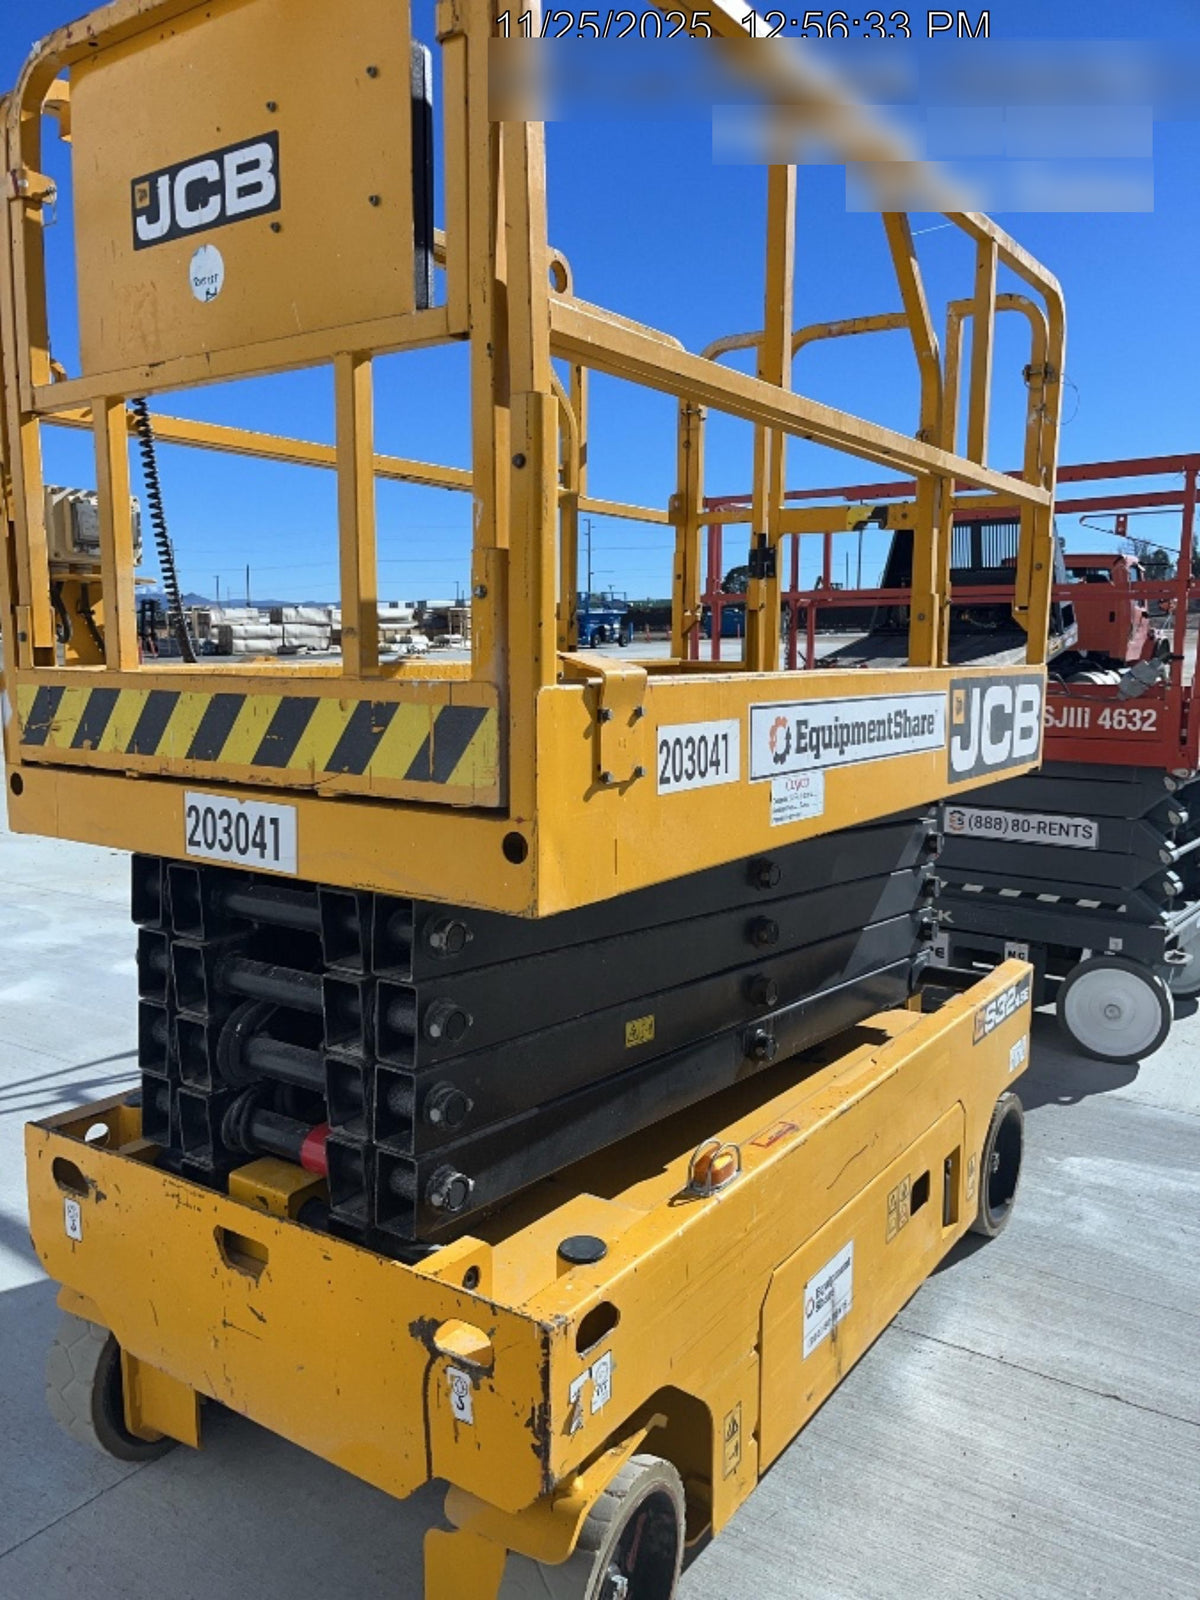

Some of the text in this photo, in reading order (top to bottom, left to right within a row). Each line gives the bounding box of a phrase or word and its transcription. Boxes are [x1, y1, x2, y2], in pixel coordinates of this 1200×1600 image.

[136, 142, 276, 241] JCB
[795, 709, 934, 759] EquipmentShare
[951, 684, 1040, 772] JCB
[1097, 707, 1157, 732] 4632
[659, 732, 728, 785] 203041
[187, 805, 279, 861] 203041
[968, 813, 1008, 834] (888)
[1011, 818, 1093, 839] 80-RENTS
